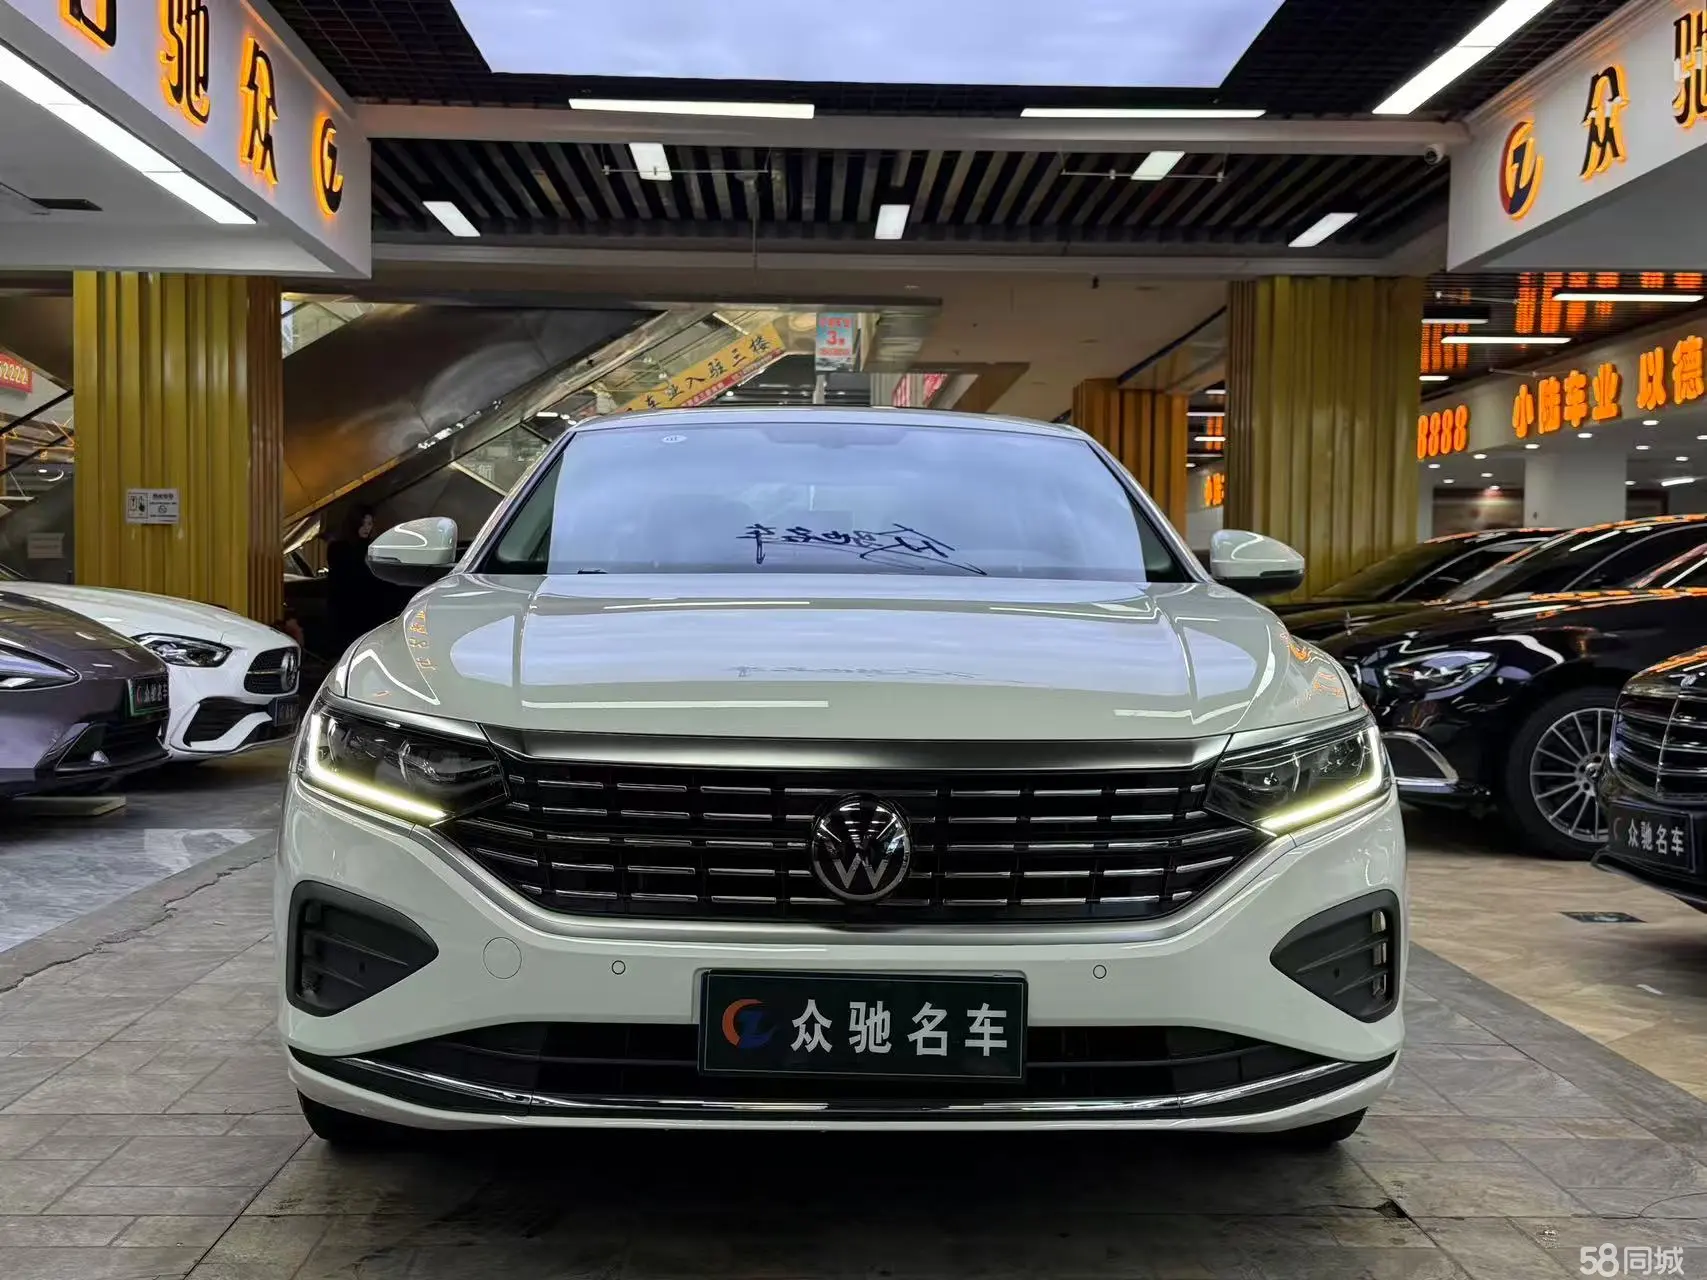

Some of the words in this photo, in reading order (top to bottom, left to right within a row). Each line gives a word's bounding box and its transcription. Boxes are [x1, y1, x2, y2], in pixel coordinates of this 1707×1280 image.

[0, 360, 29, 384] 2222
[626, 334, 771, 411] 车业入驻三楼
[1417, 405, 1468, 460] 8888
[1628, 818, 1685, 856] 众驰名车
[790, 998, 1008, 1057] 众驰名车
